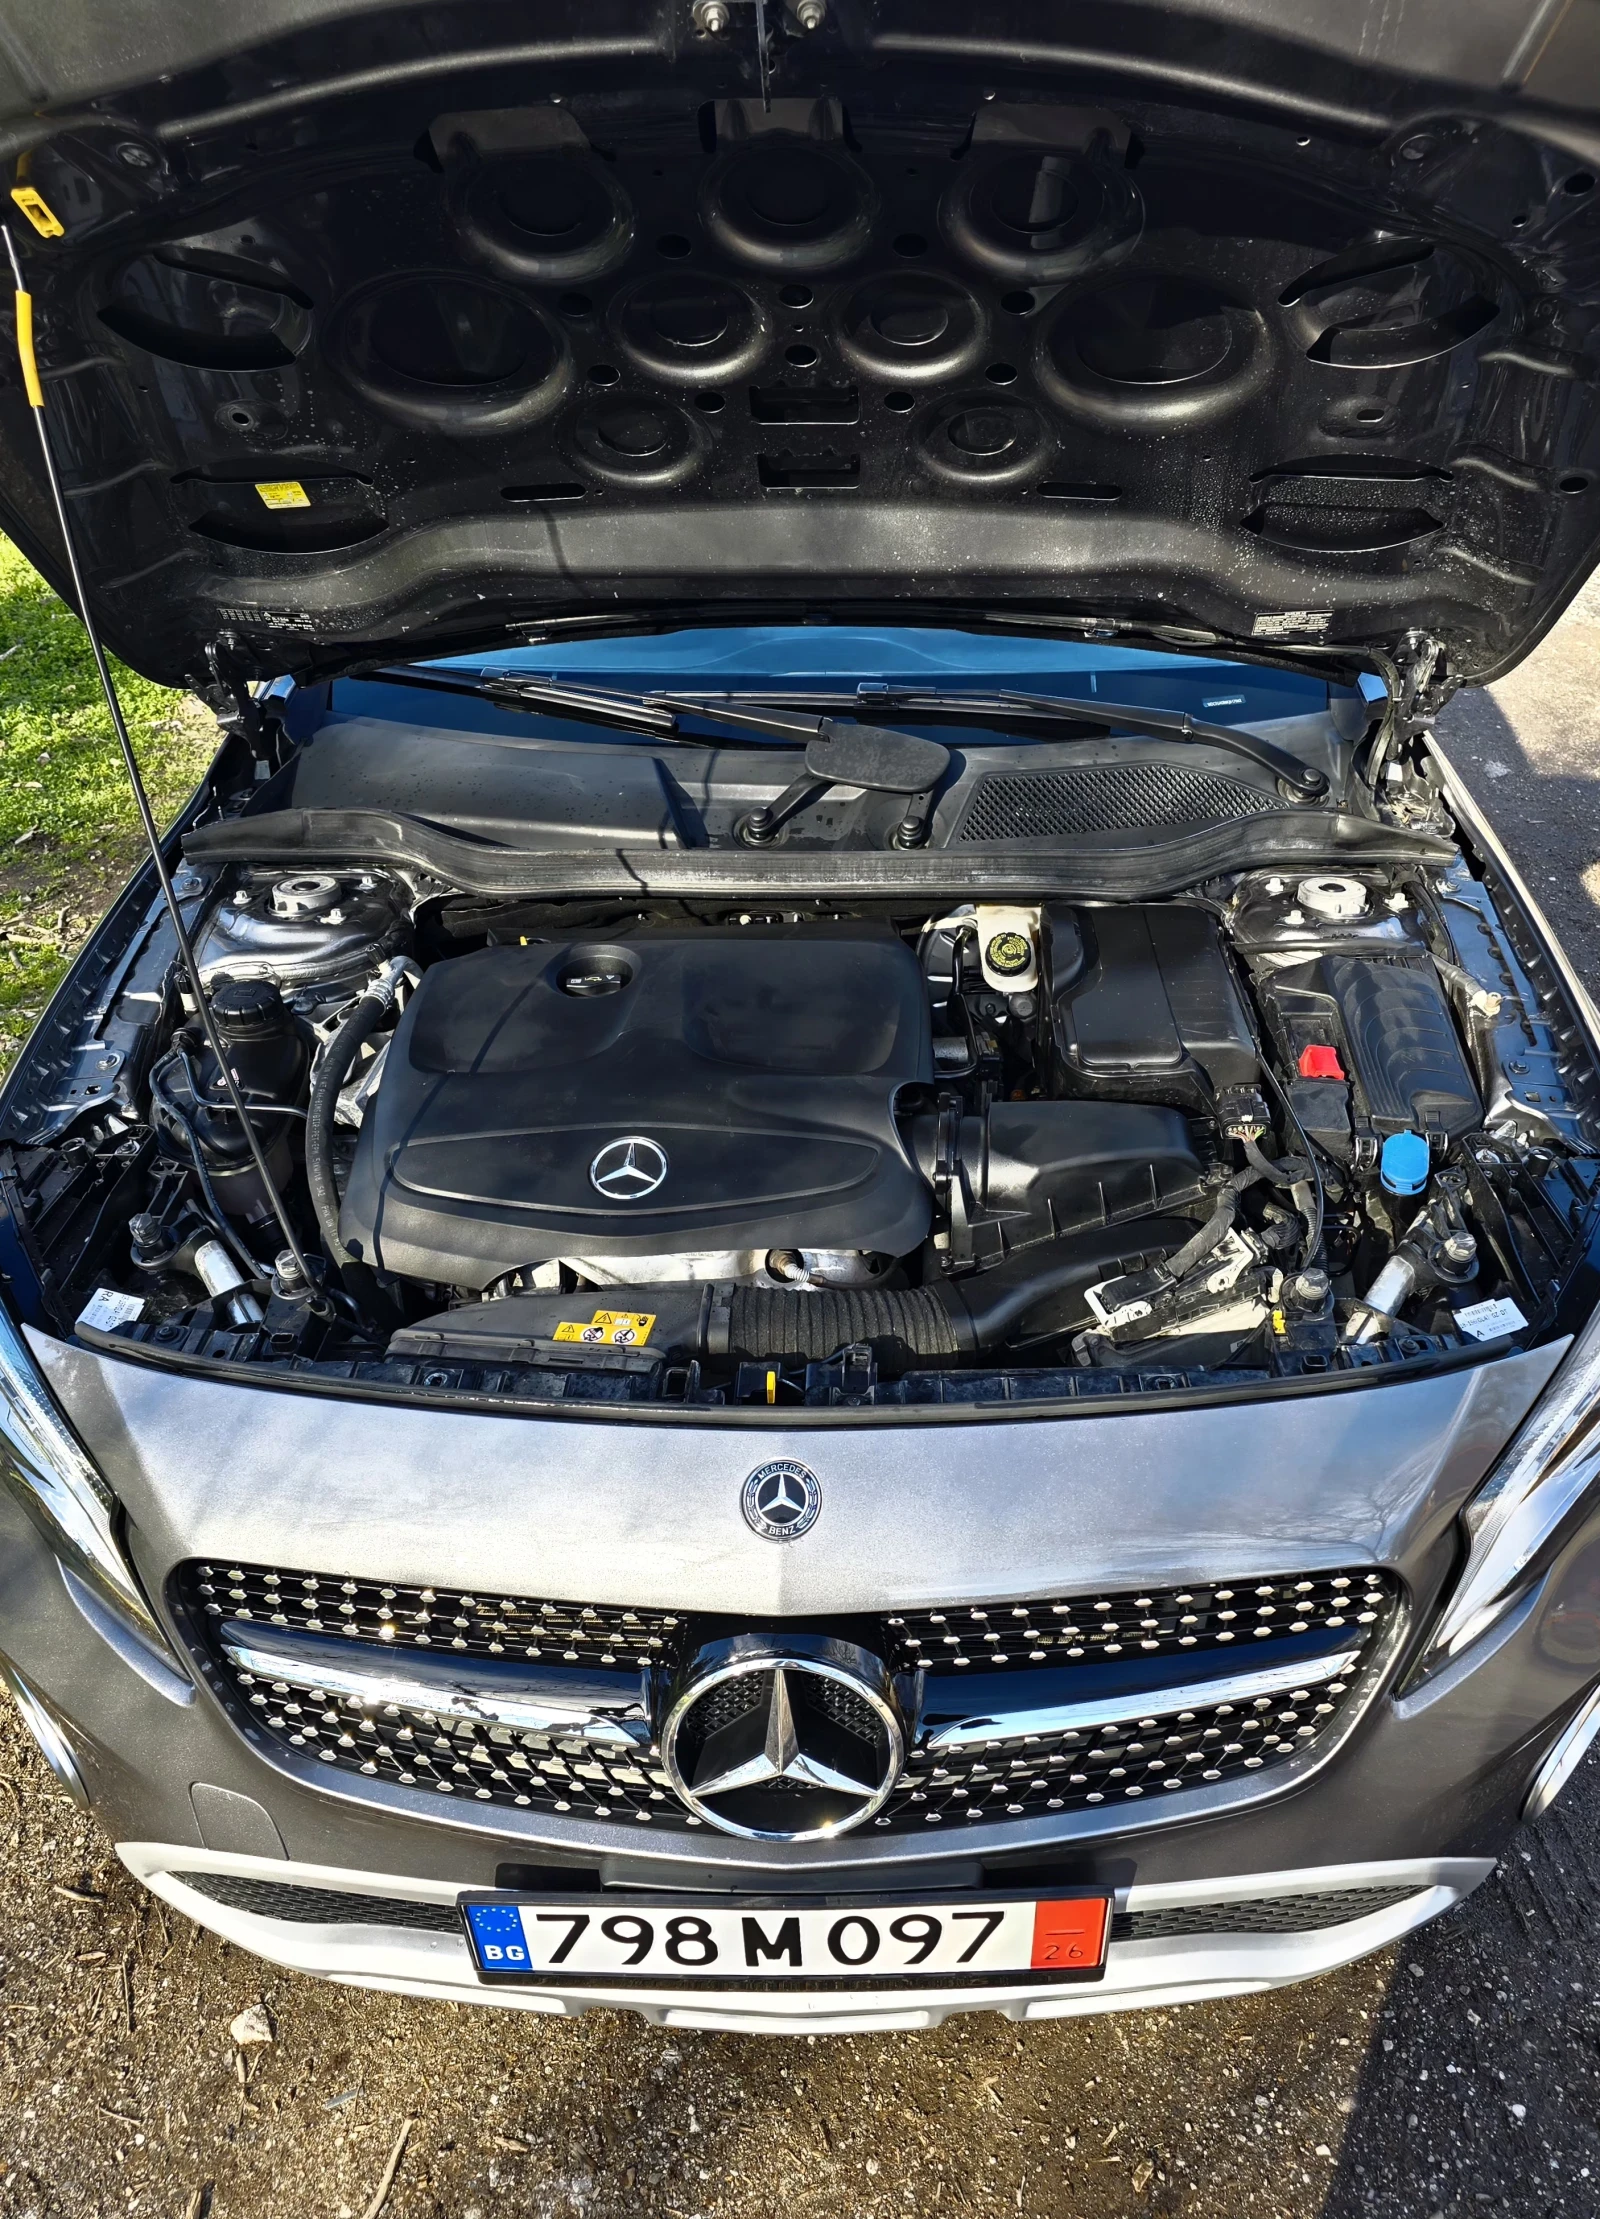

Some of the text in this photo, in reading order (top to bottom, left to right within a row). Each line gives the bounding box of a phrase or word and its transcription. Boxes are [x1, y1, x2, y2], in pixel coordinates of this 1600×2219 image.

[757, 1463, 807, 1480] MERCEDES
[768, 1525, 796, 1536] BENZ
[536, 1911, 1005, 1967] 798 M 097
[482, 1944, 525, 1961] BG
[1044, 1944, 1084, 1961] 26
